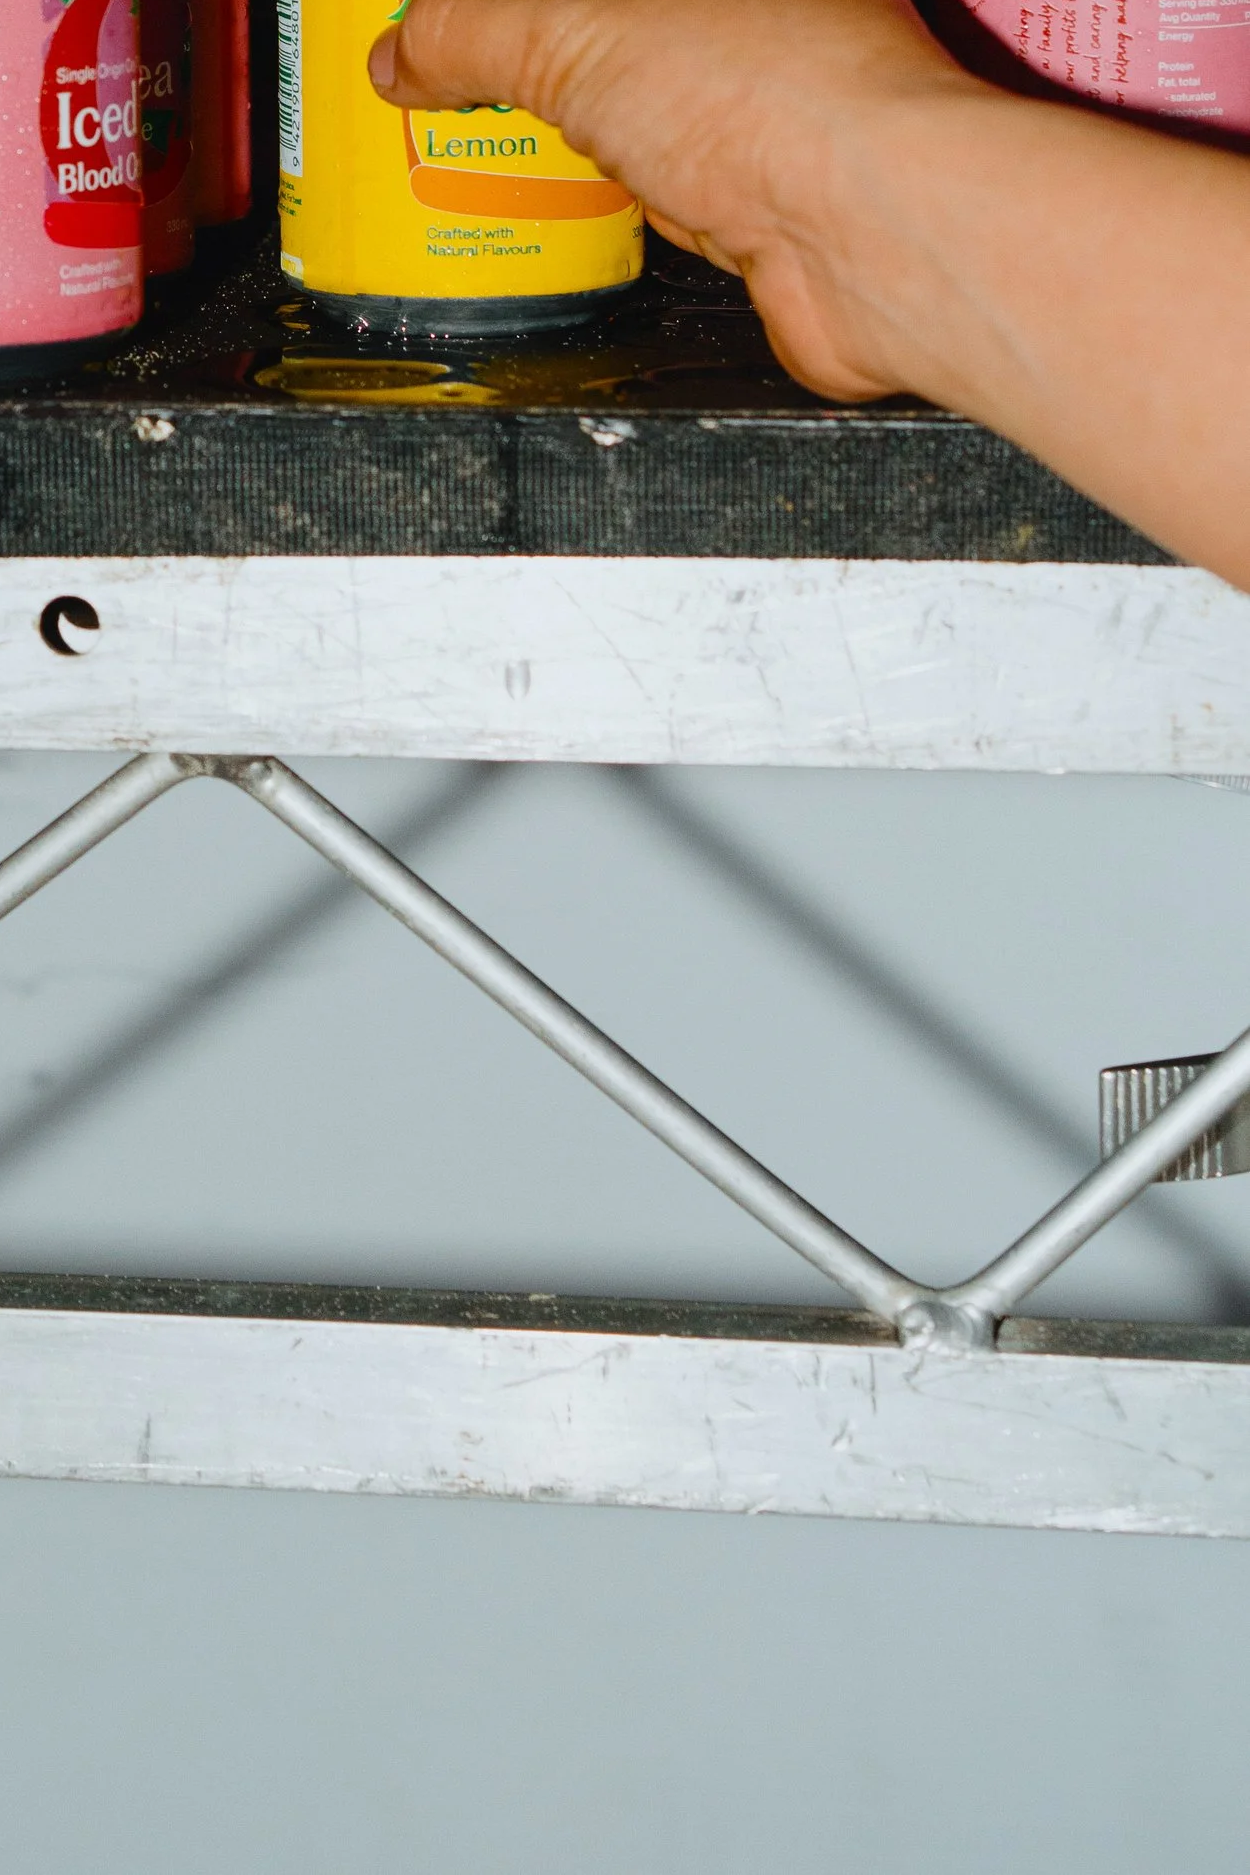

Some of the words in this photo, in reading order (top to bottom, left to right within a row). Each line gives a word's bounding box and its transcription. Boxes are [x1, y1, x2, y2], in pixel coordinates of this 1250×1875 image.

[1038, 4, 1058, 52] family
[1062, 9, 1080, 53] profits
[1090, 3, 1106, 49] caring
[56, 66, 96, 85] Single
[1042, 59, 1049, 69] a
[1066, 61, 1074, 81] our
[1086, 55, 1100, 82] and
[1110, 33, 1132, 83] helping
[56, 79, 138, 150] Iced
[292, 70, 300, 143] 421907
[426, 129, 538, 158] Lemon
[58, 155, 123, 196] Blood
[426, 226, 480, 240] Crafted
[485, 225, 514, 239] with
[426, 243, 478, 257] Natural
[482, 242, 541, 256] Flavours
